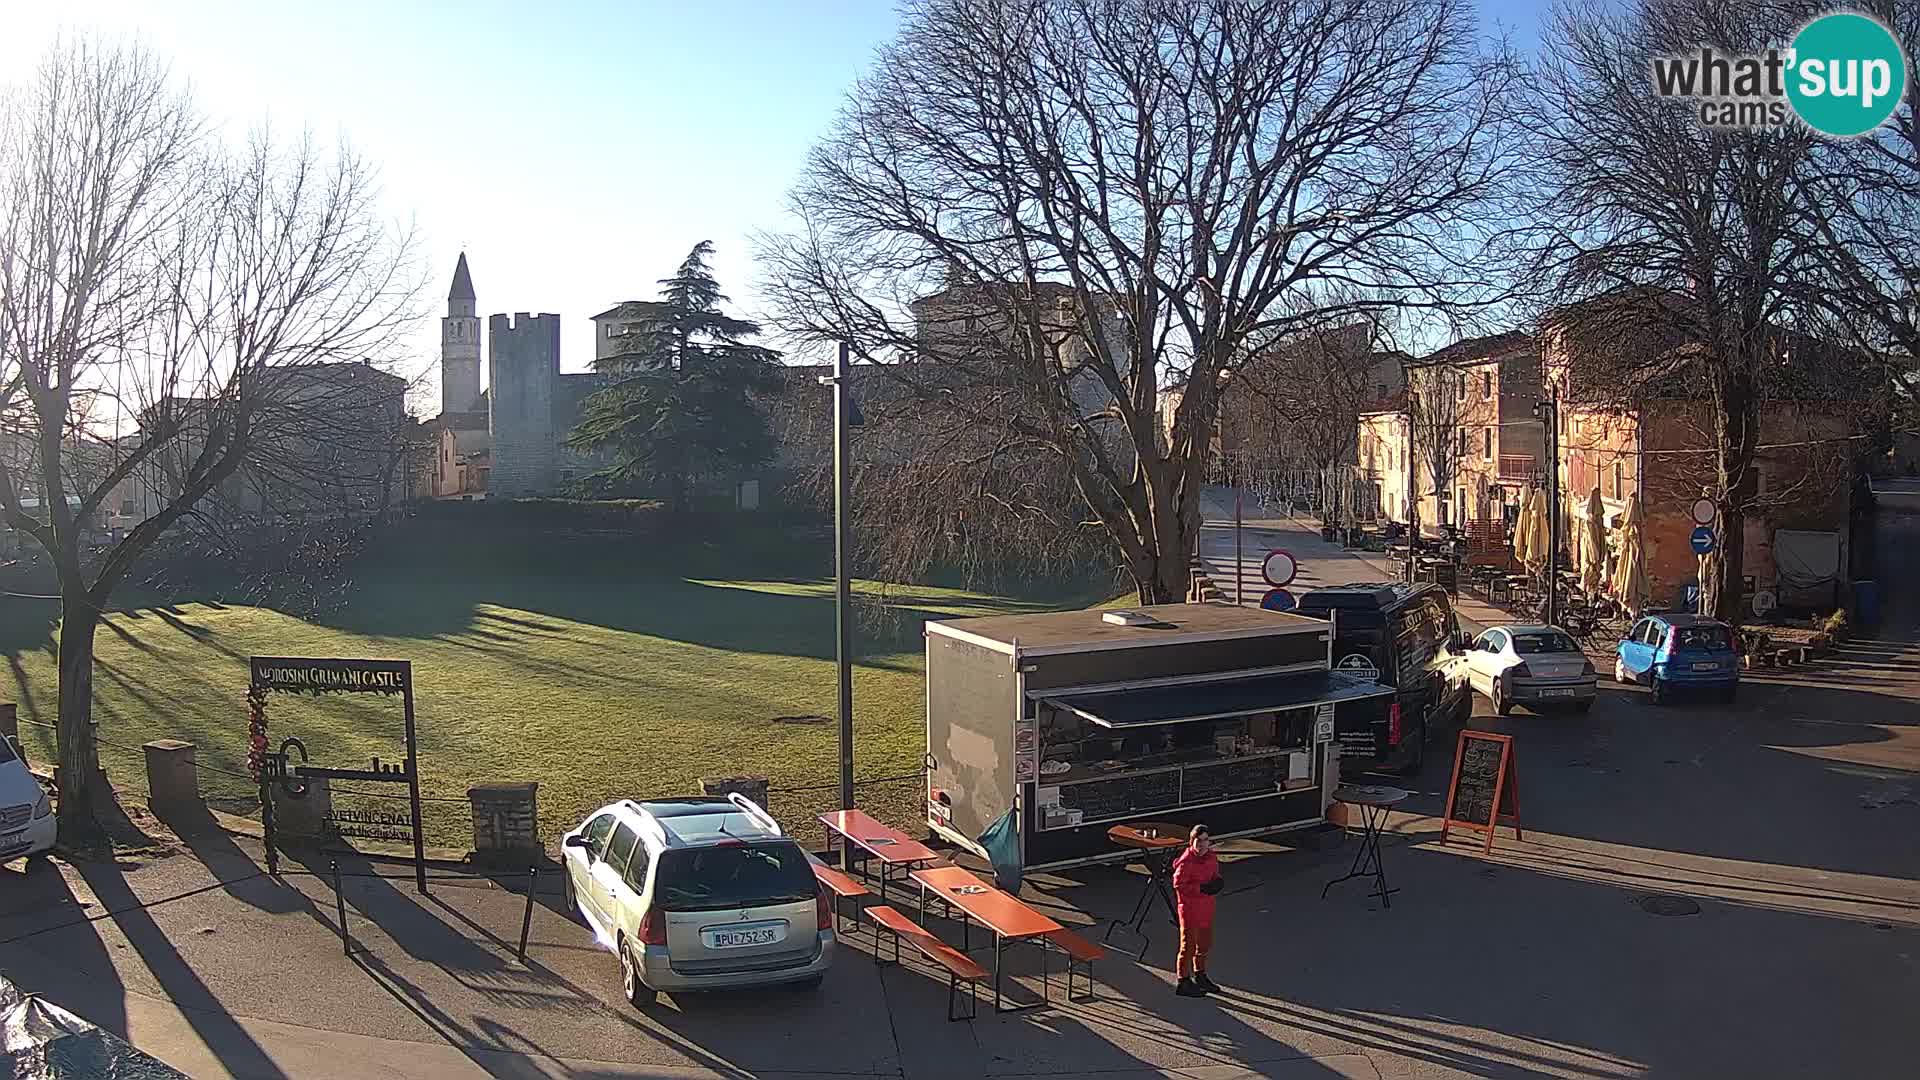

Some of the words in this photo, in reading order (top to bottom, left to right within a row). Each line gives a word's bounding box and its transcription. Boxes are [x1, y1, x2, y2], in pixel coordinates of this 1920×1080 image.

[259, 666, 309, 684] MOROSINI
[310, 667, 361, 686] GRIMANI
[362, 670, 404, 687] CASTLE
[721, 933, 734, 945] PU
